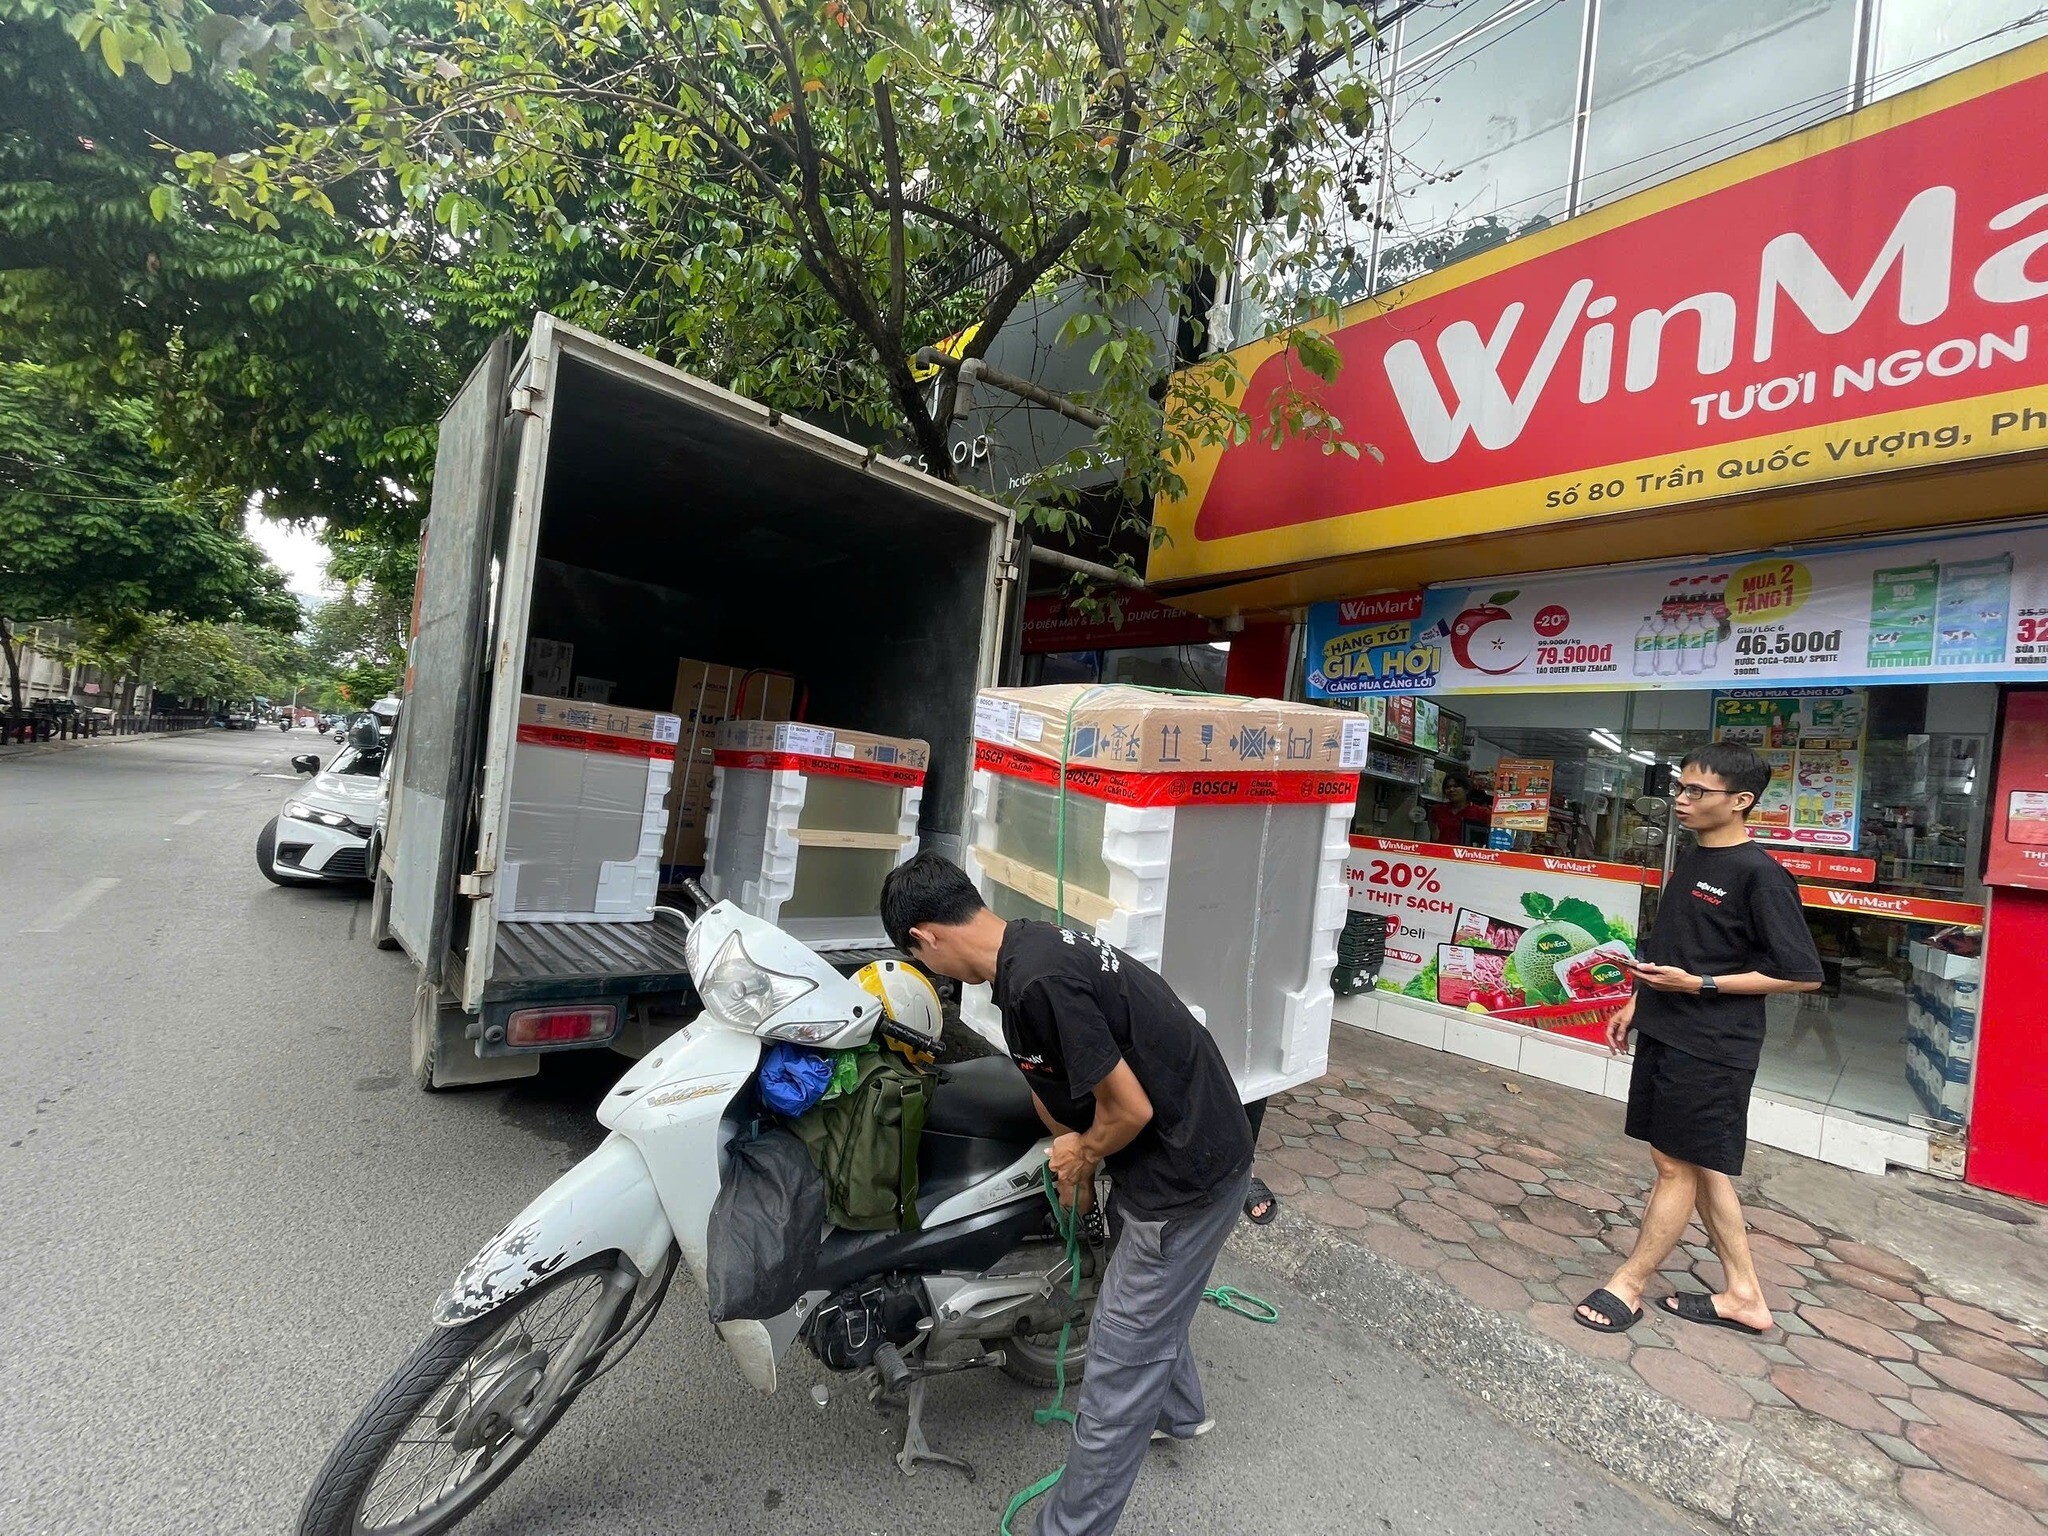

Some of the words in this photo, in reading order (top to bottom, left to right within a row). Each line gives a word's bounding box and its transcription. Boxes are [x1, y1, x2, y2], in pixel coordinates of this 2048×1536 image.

[1690, 371, 1816, 425] TƯƠI
[1832, 325, 2029, 397] NGON
[1545, 483, 1582, 508] Số
[1588, 479, 1625, 501] 80
[1636, 463, 1704, 493] Trần
[1717, 445, 1811, 479] Quốc
[1825, 425, 1972, 458] Vượng,
[1743, 572, 1776, 593] MUA
[1780, 564, 1794, 584] 2
[1783, 585, 1794, 606] 1
[1331, 634, 1374, 655] HÀNG
[1377, 624, 1410, 642] TỐT
[1736, 630, 1843, 655] 46.500đ
[1323, 646, 1374, 679] GIÁ
[1537, 643, 1613, 665] 79.900đ
[1809, 654, 1838, 662] SPRITE
[1549, 666, 1569, 674] QUEEN
[1588, 664, 1617, 672] ZEALAND
[1330, 680, 1357, 691] CÀNG
[1359, 681, 1380, 689] MUA
[1383, 677, 1411, 688] CÀNG
[1764, 688, 1788, 697] MUA
[812, 759, 840, 770] BOSCH
[893, 772, 918, 782] BOSCH
[1192, 781, 1239, 796] BOSCH
[1317, 782, 1352, 795] BOSCH
[1369, 860, 1441, 893] 20%
[1367, 889, 1403, 907] THỊT
[1406, 896, 1453, 914] SẠCH
